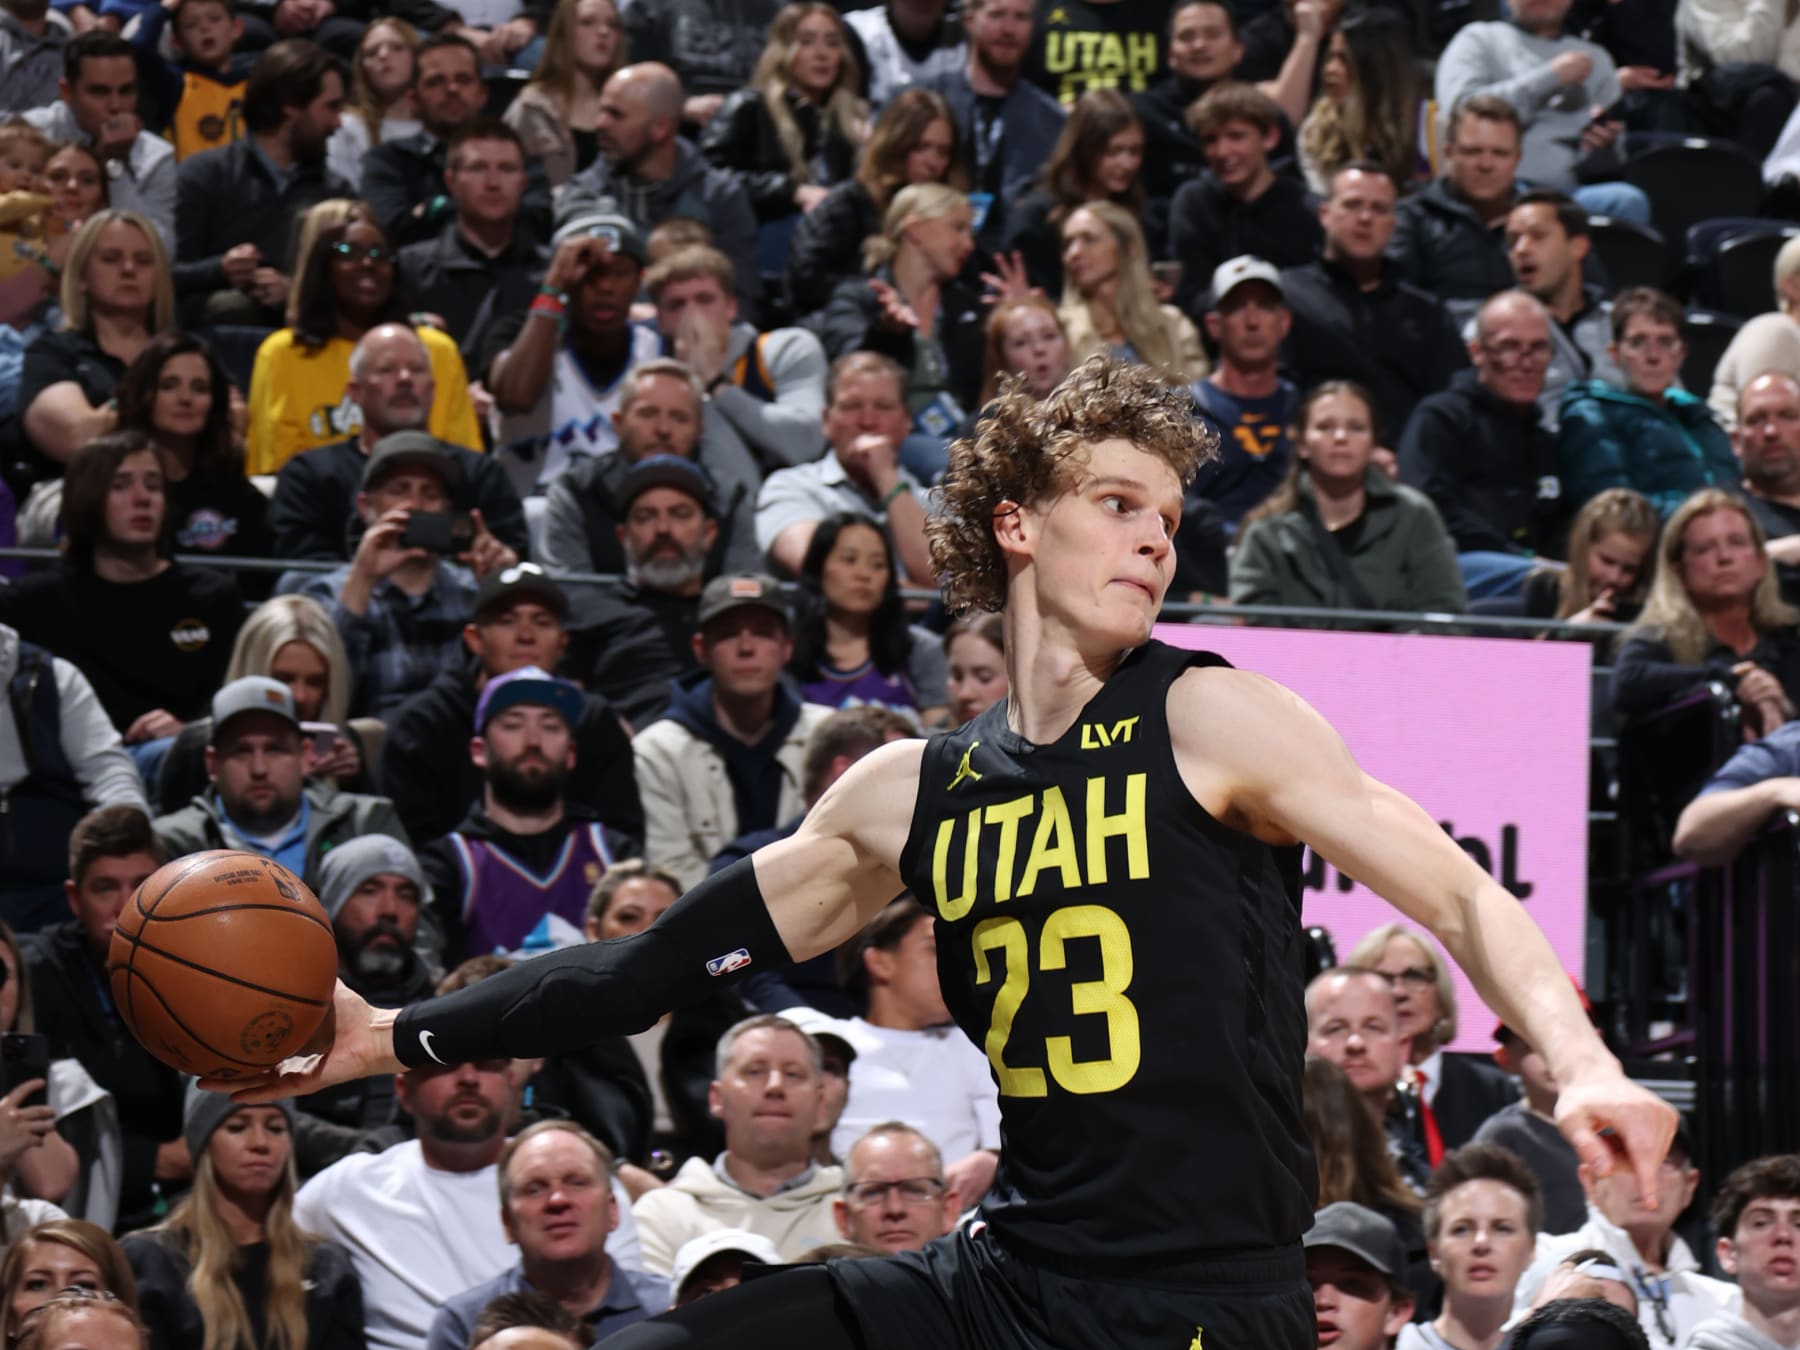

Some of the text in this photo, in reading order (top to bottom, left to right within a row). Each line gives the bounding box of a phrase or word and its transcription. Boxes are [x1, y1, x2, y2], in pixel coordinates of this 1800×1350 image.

[1045, 30, 1157, 75] UTAH
[1081, 715, 1140, 750] LVT
[933, 772, 1150, 922] UTAH
[972, 904, 1141, 1098] 23
